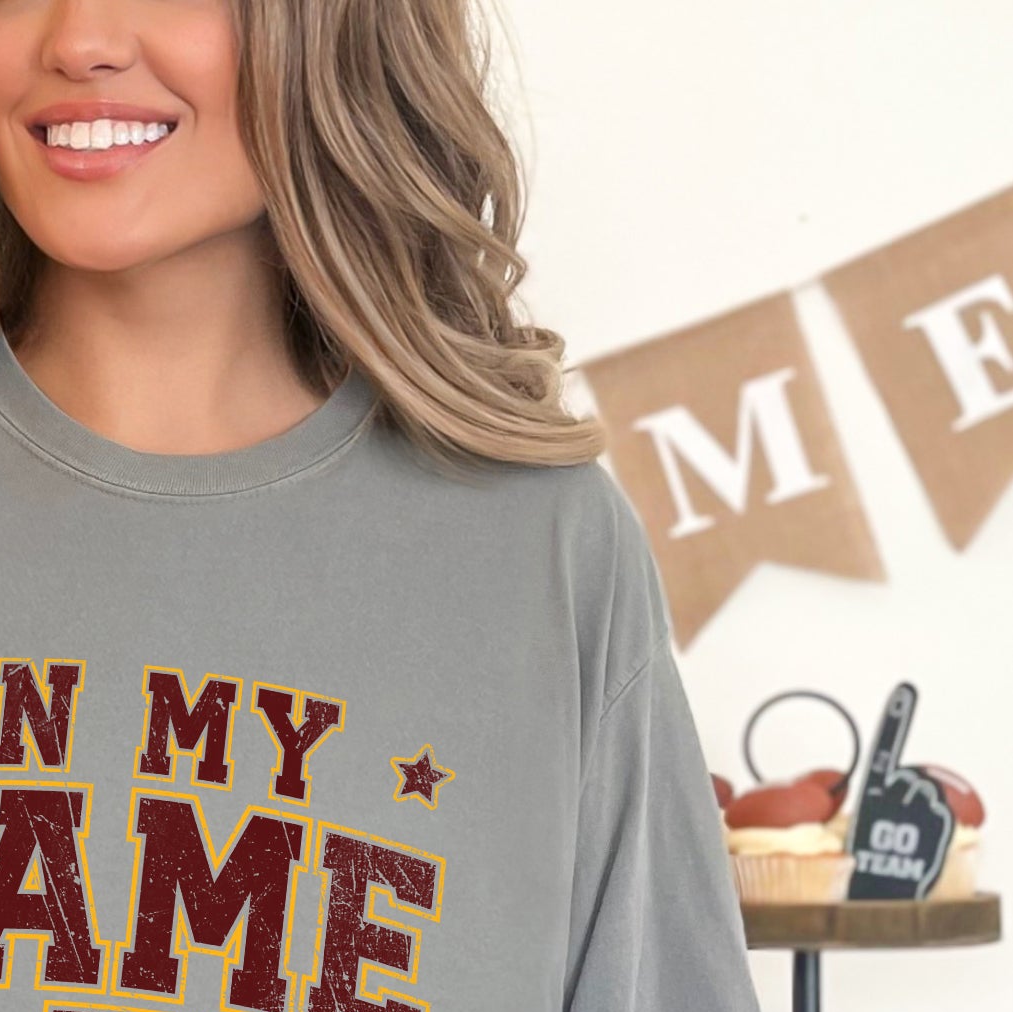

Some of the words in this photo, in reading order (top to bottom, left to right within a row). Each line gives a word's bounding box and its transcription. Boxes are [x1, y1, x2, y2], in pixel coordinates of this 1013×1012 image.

[133, 664, 347, 807] MY
[869, 819, 920, 855] GO
[856, 850, 926, 882] TEAM
